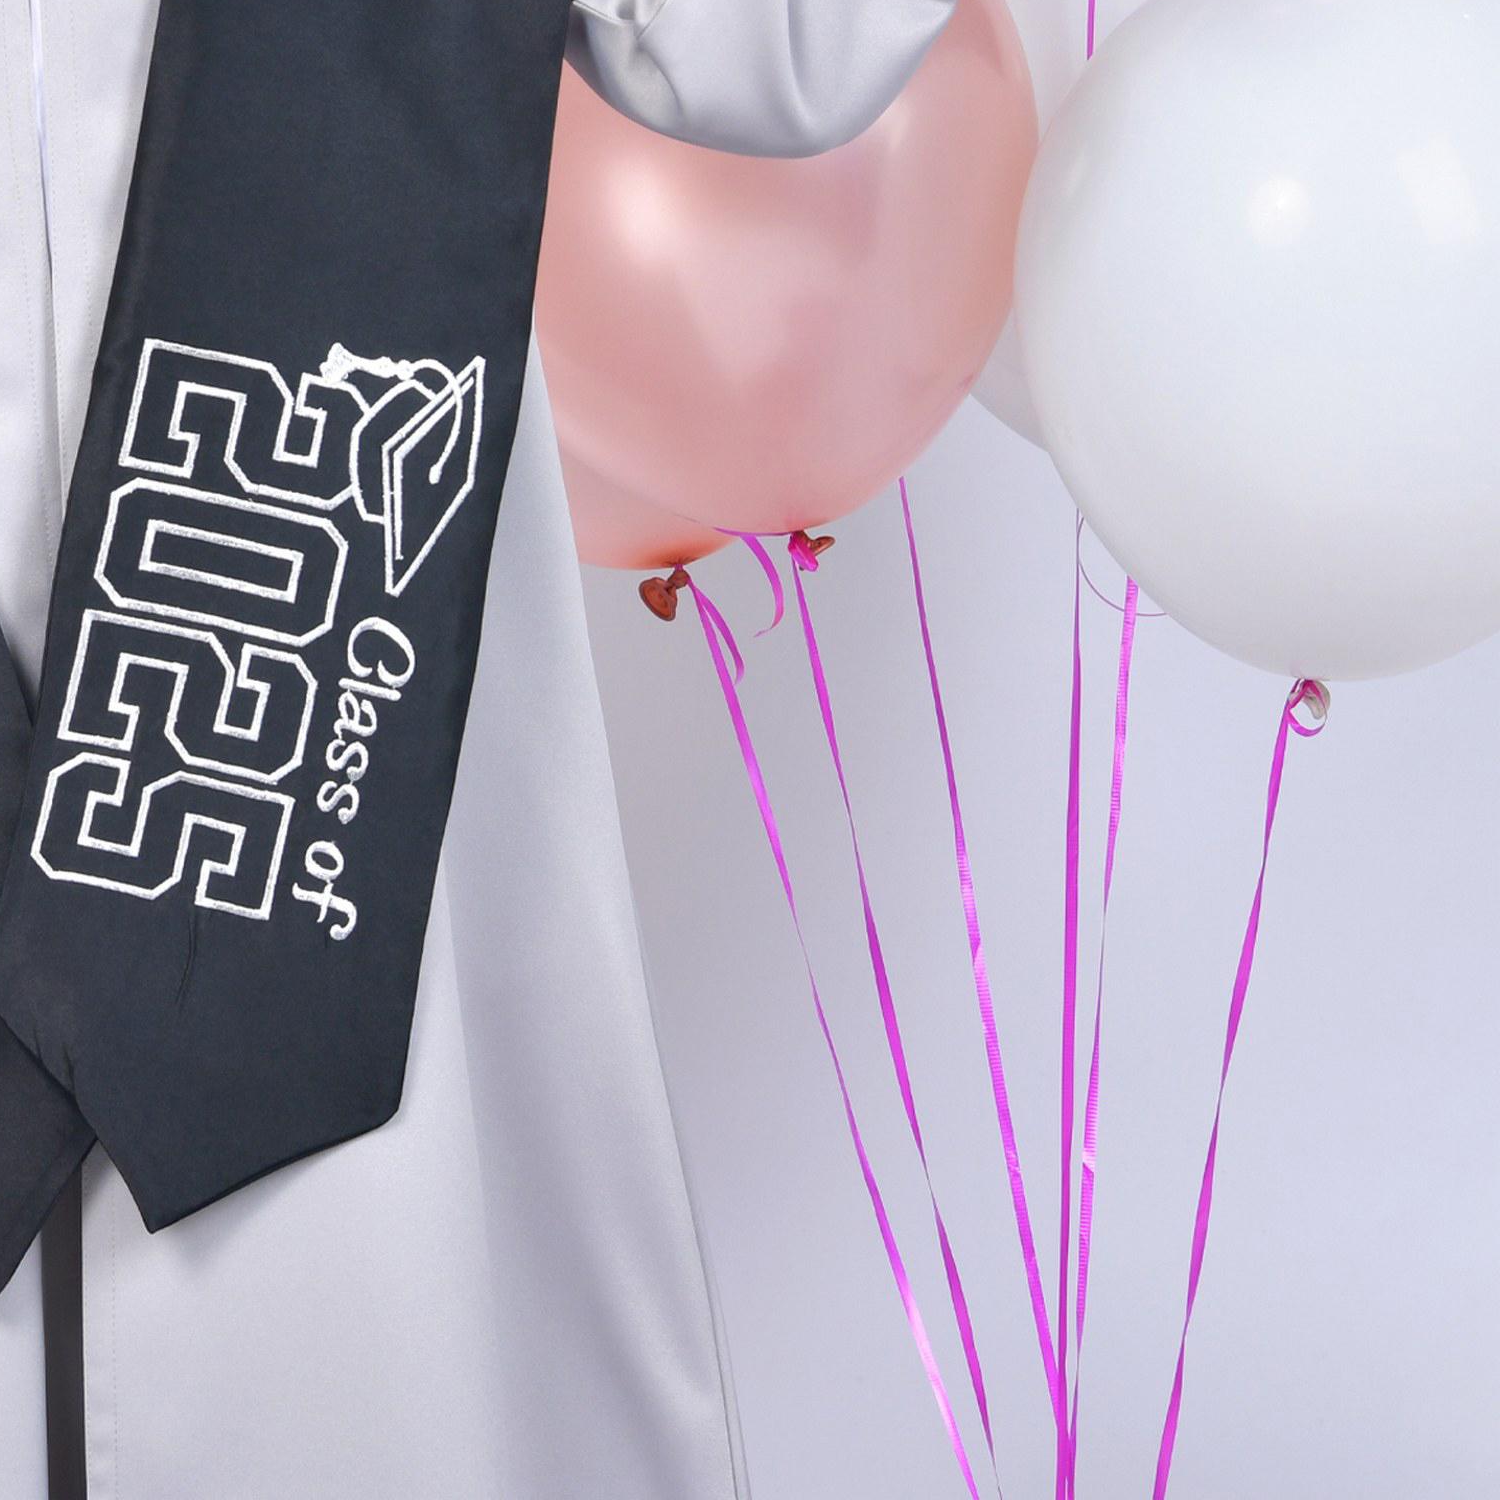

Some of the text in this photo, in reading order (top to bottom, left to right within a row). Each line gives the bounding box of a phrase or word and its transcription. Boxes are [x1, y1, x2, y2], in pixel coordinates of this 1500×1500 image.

[28, 336, 370, 922] 2025
[290, 615, 417, 941] Class of
